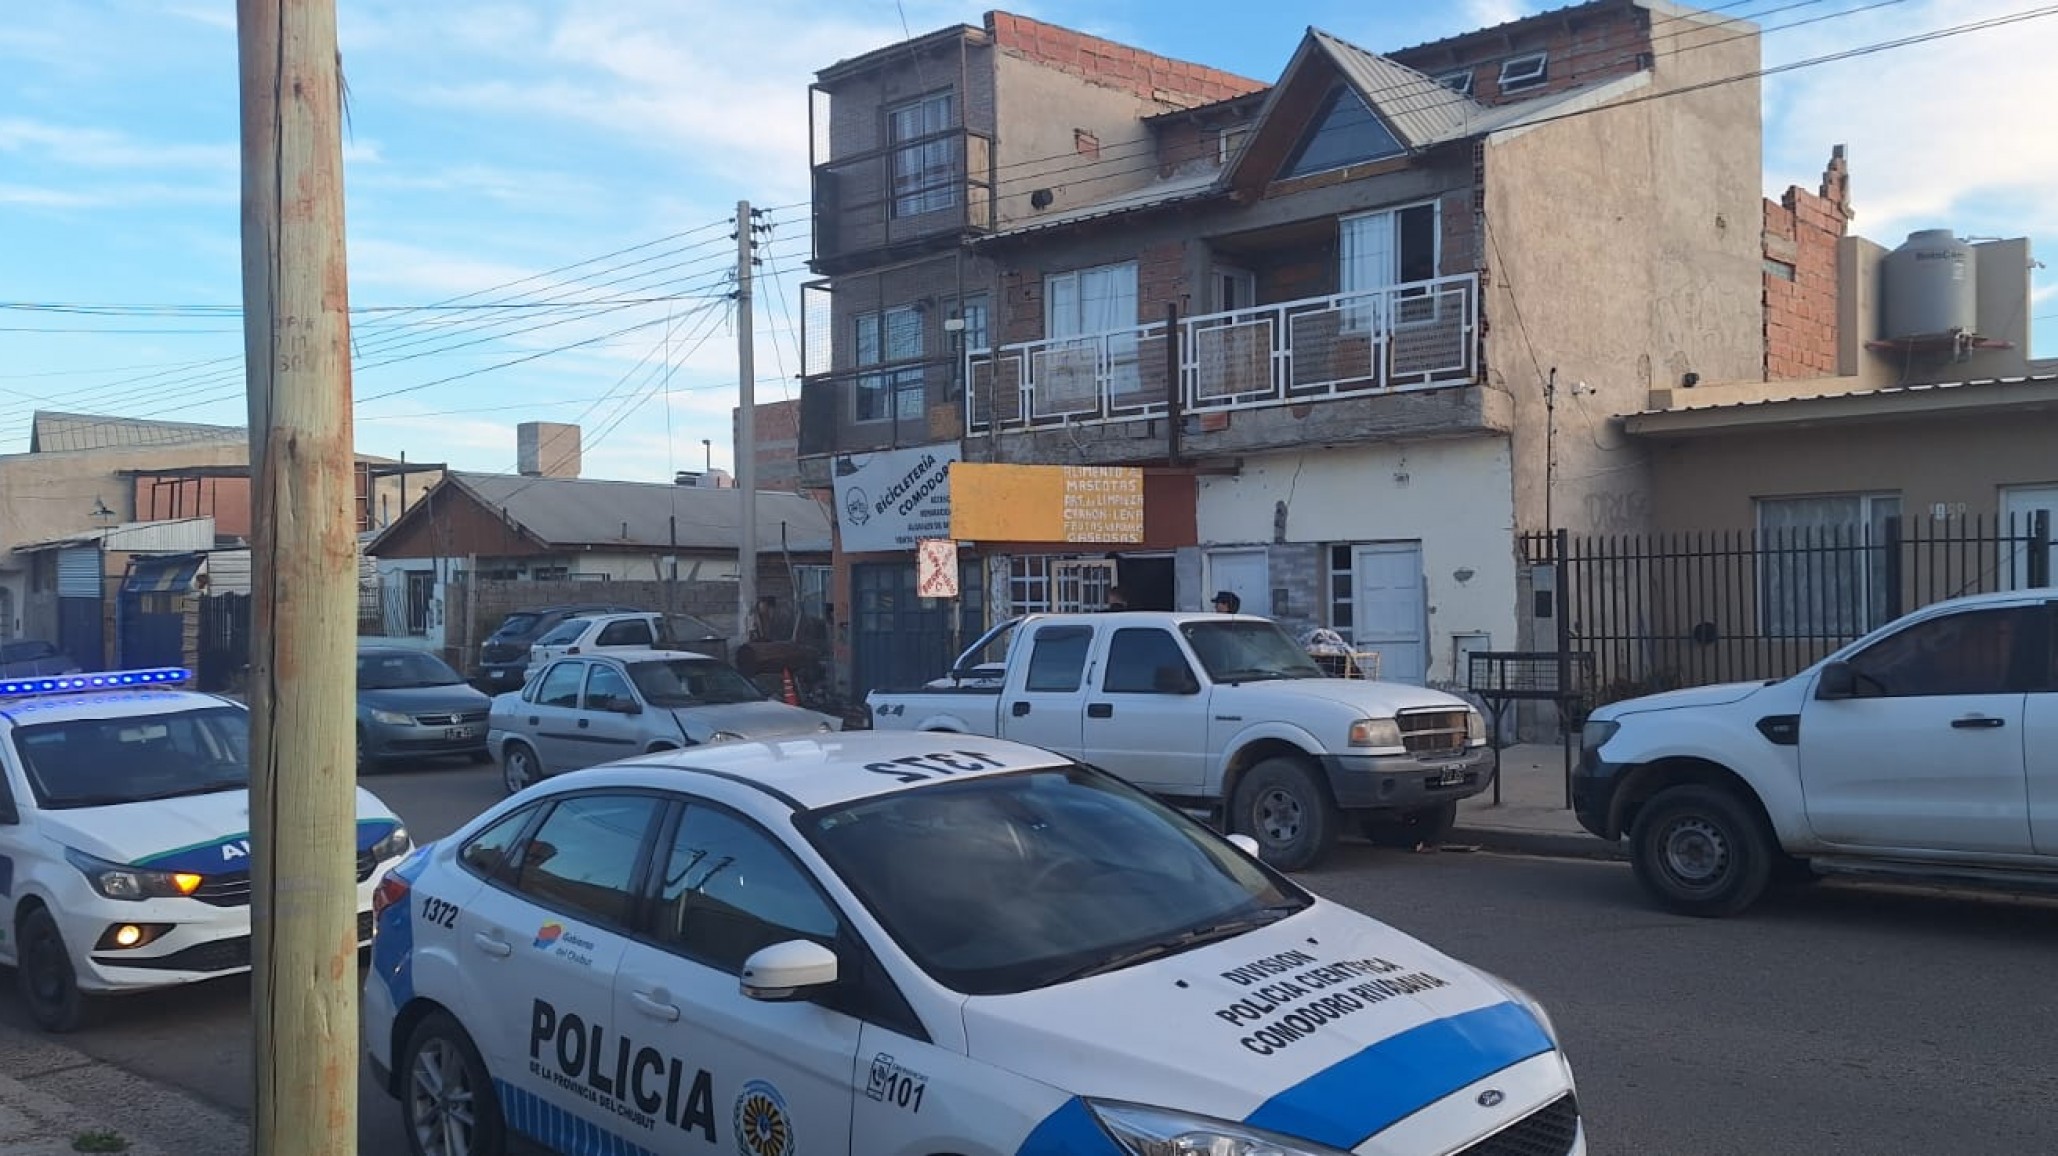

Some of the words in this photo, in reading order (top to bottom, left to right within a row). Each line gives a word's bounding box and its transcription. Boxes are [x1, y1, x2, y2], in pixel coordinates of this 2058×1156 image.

[1067, 480, 1137, 493] MASCOTAS
[421, 896, 460, 930] 1372
[1220, 949, 1318, 986] DIVISION
[1215, 976, 1312, 1027] POLICIA
[1240, 992, 1366, 1055] COMODORO
[1352, 972, 1452, 1005] RIVADAVIA
[530, 998, 718, 1143] POLICIA
[888, 1072, 926, 1114] 101
[529, 1061, 541, 1076] DE
[541, 1067, 552, 1080] LA
[553, 1072, 598, 1103] PROVINCIA
[599, 1094, 617, 1113] DEL
[617, 1104, 656, 1132] CHUBUT
